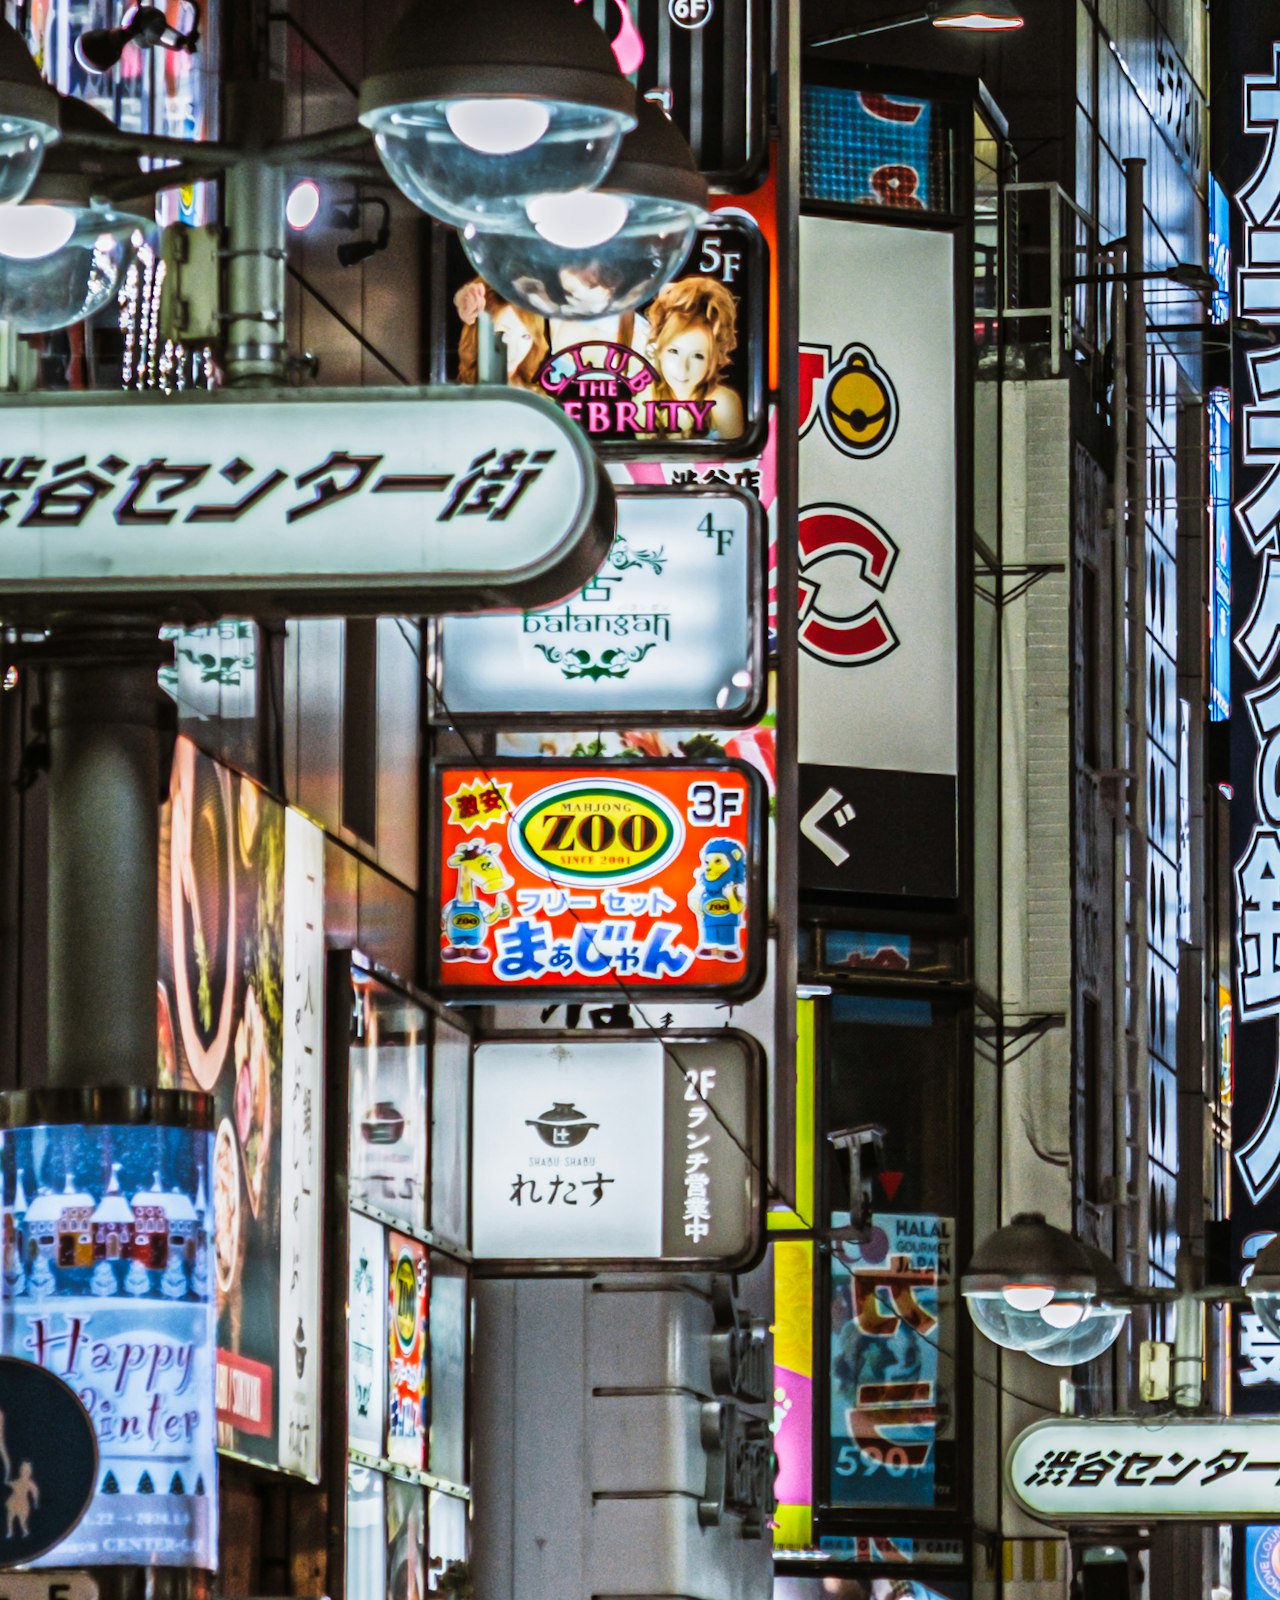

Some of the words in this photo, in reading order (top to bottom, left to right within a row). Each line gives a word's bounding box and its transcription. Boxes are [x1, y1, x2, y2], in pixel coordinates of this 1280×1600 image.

[701, 237, 742, 283] 5F
[539, 343, 661, 397] CLUB
[578, 379, 618, 398] THE
[697, 511, 735, 556] 4F
[561, 802, 632, 813] MAHJONG
[692, 784, 740, 824] 3F
[541, 814, 658, 853] ZOO
[560, 855, 595, 865] SINCE
[600, 855, 632, 865] 2001
[519, 890, 593, 915] フリー
[602, 890, 673, 915] セット
[498, 920, 688, 975] まぁじゃん
[528, 1157, 560, 1167] SHABU
[564, 1157, 596, 1167] SHABU
[682, 1107, 711, 1243] ランチ営業中
[509, 1172, 615, 1207] れたす
[896, 1220, 951, 1238] HALAL
[896, 1240, 951, 1255] GOURMET
[896, 1254, 951, 1276] JAPAN
[25, 1315, 197, 1396] Happy
